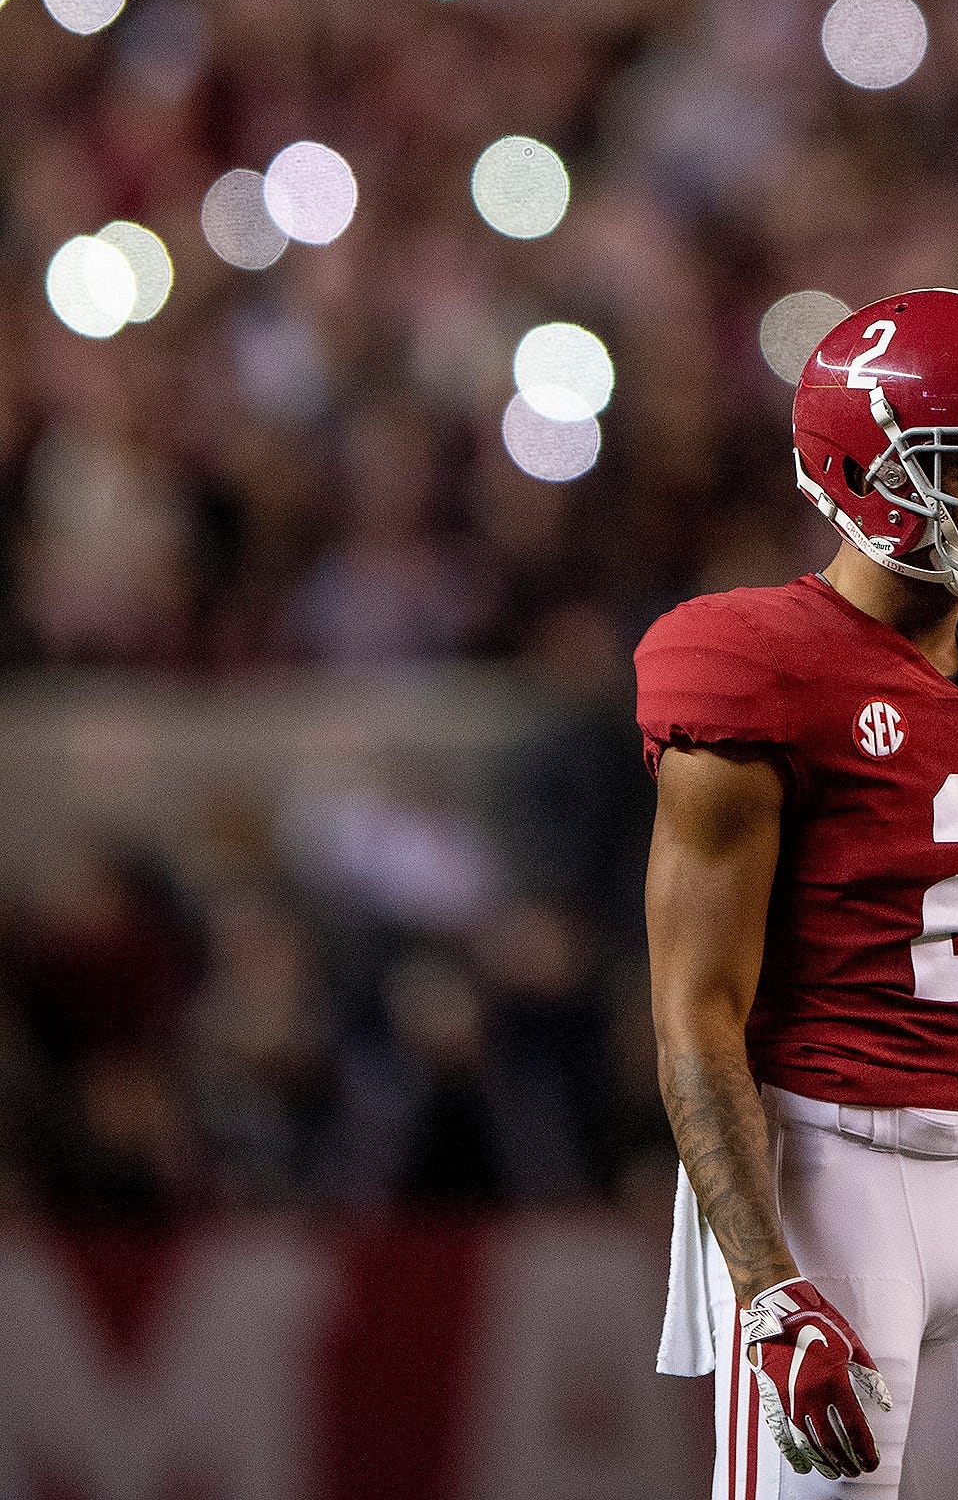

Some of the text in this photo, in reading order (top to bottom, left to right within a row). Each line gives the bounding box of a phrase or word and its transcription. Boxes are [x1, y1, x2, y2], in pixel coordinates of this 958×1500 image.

[847, 320, 897, 388] 2
[870, 541, 891, 551] chutt
[858, 702, 904, 756] SEC
